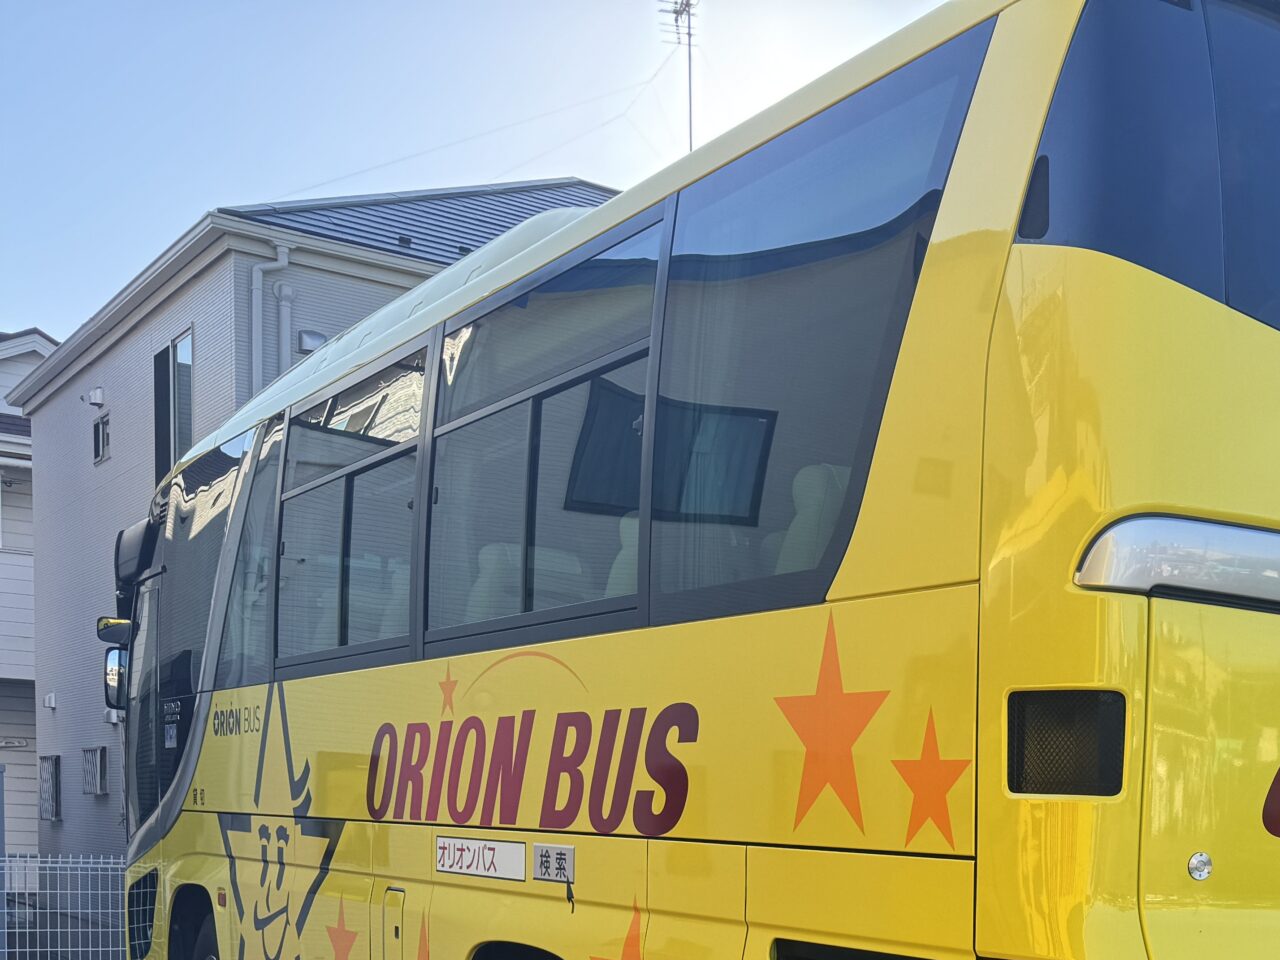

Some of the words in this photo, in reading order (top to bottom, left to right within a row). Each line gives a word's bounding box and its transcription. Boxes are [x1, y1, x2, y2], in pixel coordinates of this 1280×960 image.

[213, 706, 241, 736] ORION
[243, 705, 261, 734] BUS
[366, 709, 536, 827] ORION
[539, 702, 699, 836] BUS
[539, 849, 567, 879] 検索
